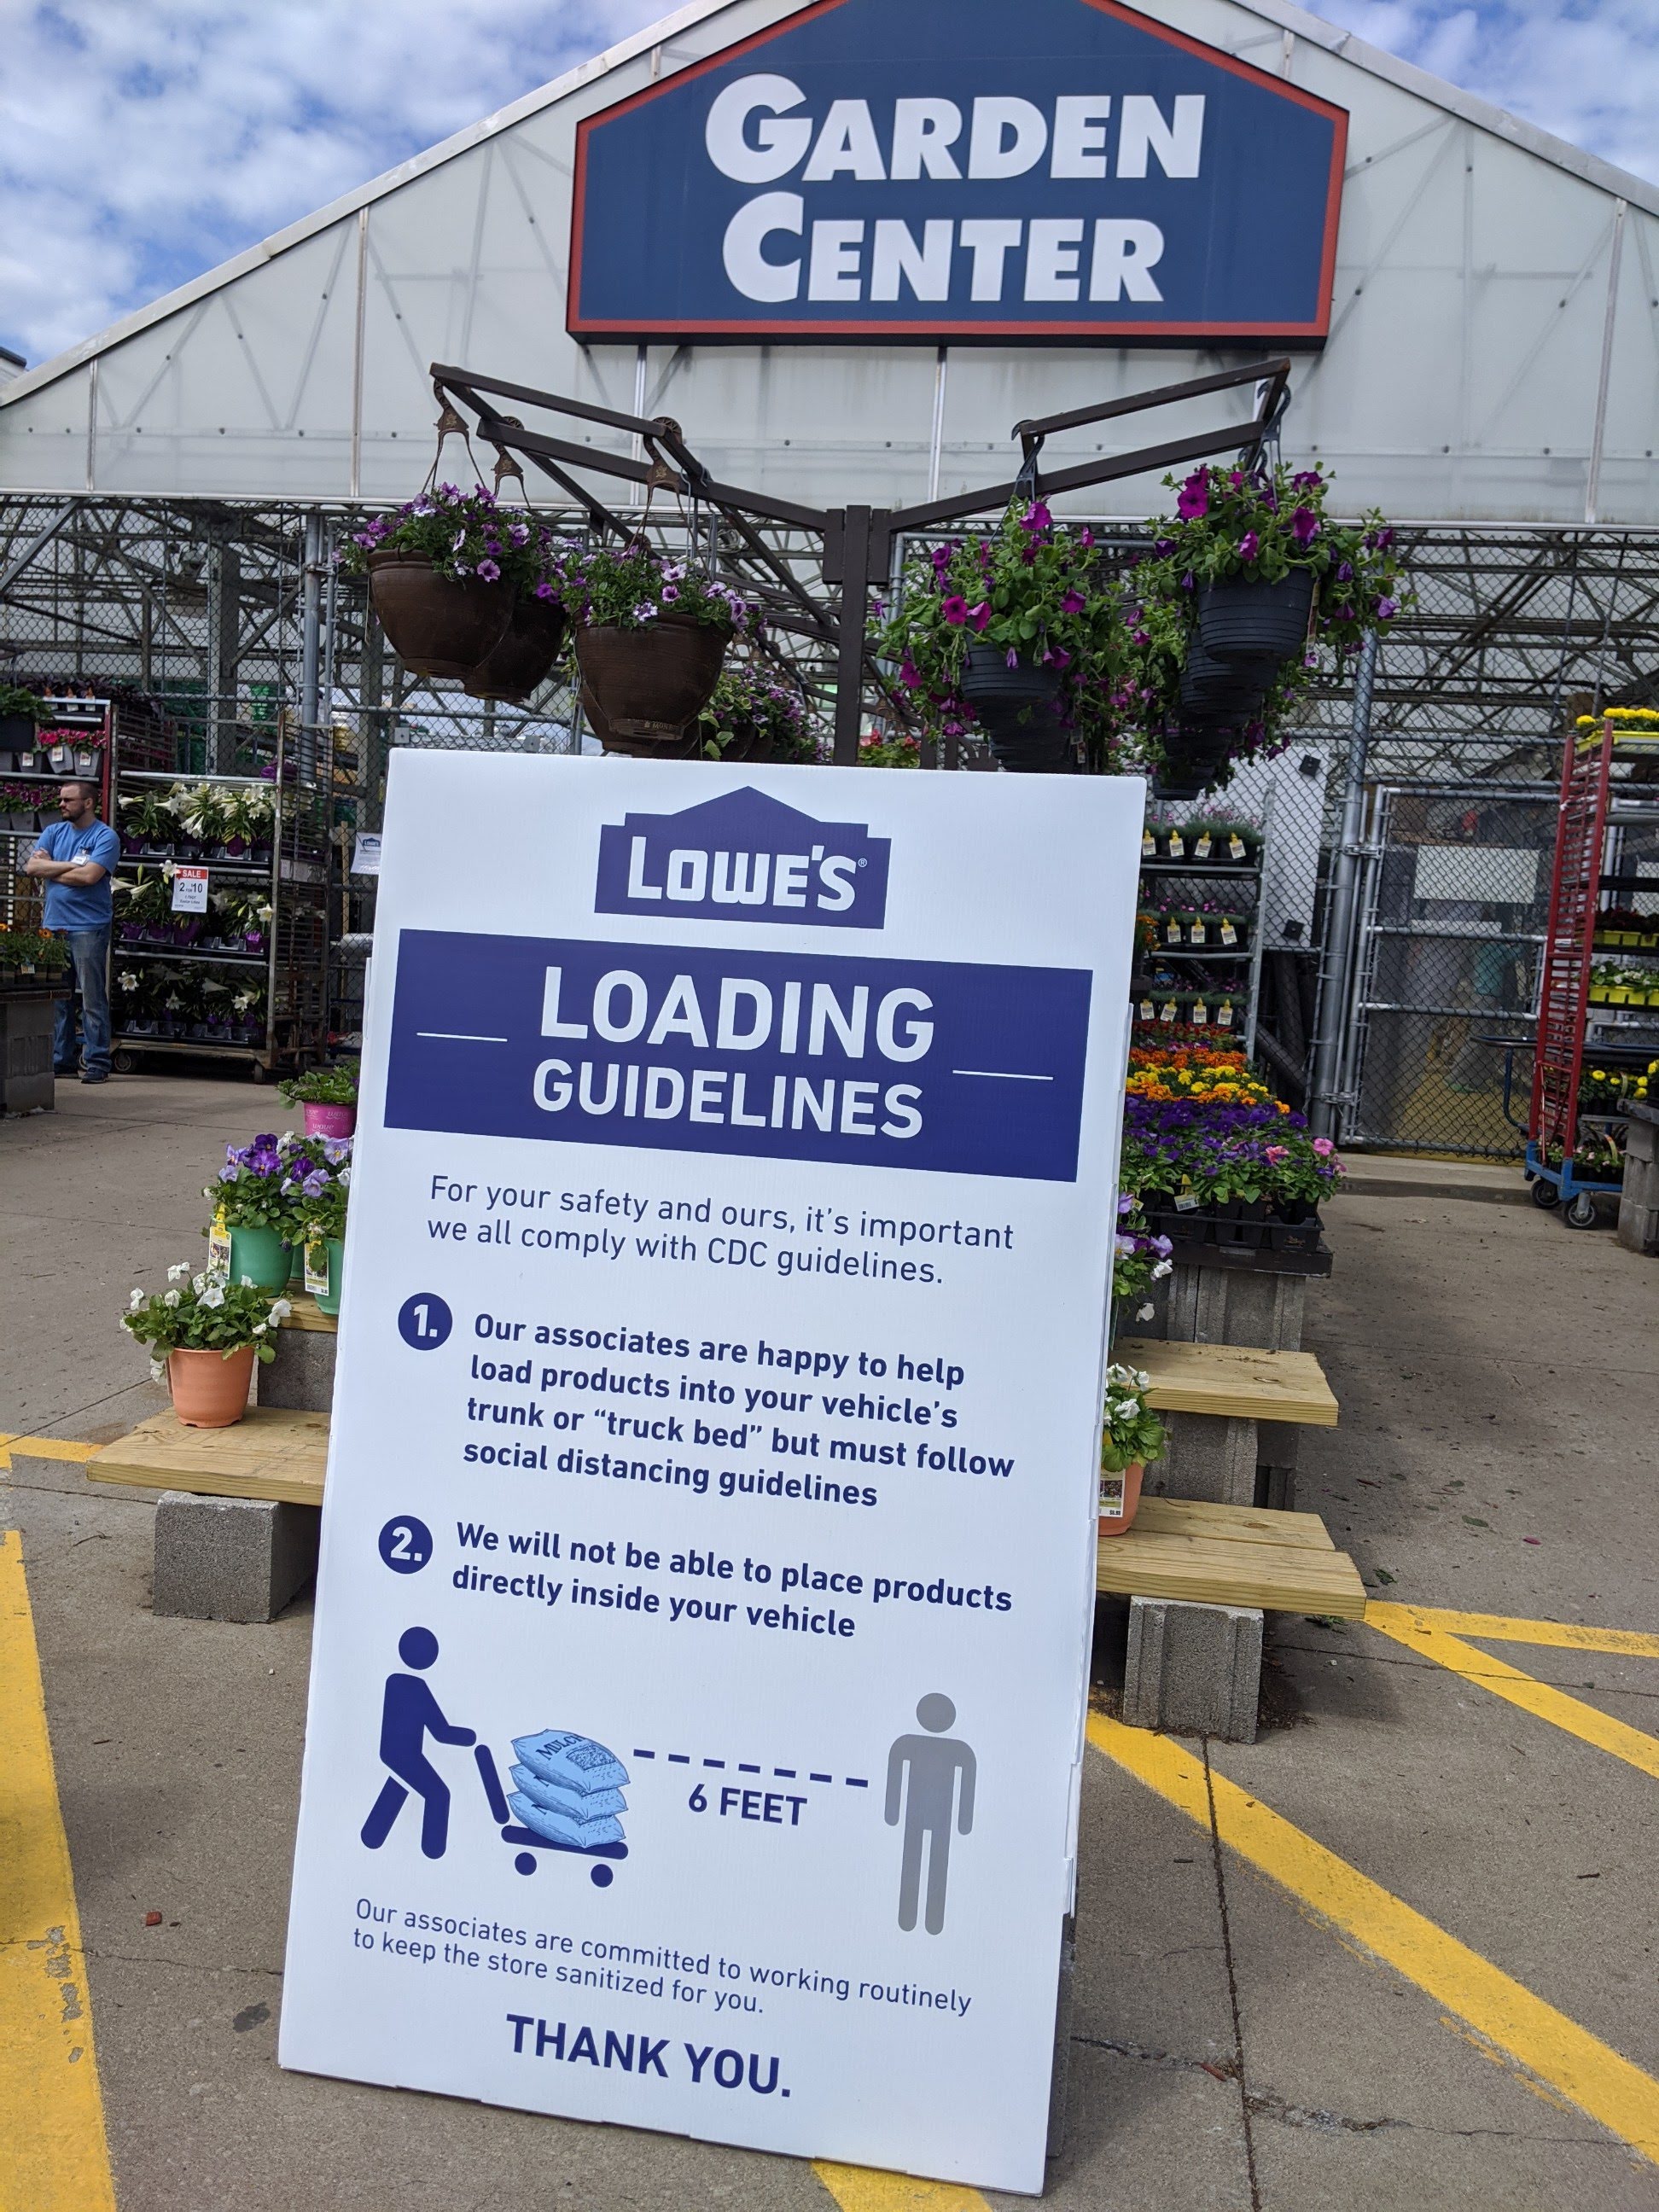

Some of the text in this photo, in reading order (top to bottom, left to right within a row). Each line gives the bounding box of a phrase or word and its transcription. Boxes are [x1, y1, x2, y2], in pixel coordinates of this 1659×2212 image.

[704, 72, 1206, 184] GARDEN
[722, 190, 1165, 303] CENTER
[179, 882, 185, 892] 2
[182, 869, 201, 878] SALE
[627, 835, 857, 911] LOWE'S
[539, 965, 935, 1064] LOADING
[533, 1058, 924, 1140] GUIDELINES
[431, 1174, 478, 1203] For
[486, 1186, 551, 1211] your
[559, 1188, 649, 1223] safety
[658, 1197, 712, 1223] and
[721, 1206, 795, 1234] ours,
[860, 1210, 1014, 1250] important
[428, 1219, 942, 1284] we all comply with CDC guidelines.
[413, 1304, 964, 1391] 1. Our associates are happy to help
[471, 1353, 533, 1384] load
[540, 1366, 670, 1399] products
[679, 1374, 736, 1405] into
[744, 1388, 814, 1413] your
[463, 1441, 877, 1507] social distancing guidelines
[467, 1397, 544, 1428] trunk
[553, 1411, 585, 1431] or
[771, 1427, 820, 1458] but
[830, 1440, 907, 1467] must
[917, 1442, 1016, 1478] follow
[390, 1521, 1012, 1612] 2. We will not be able to place products
[452, 1564, 856, 1638] directly inside your vehicle
[535, 1733, 587, 1761] MULCH
[688, 1783, 808, 1826] 6 FEET
[353, 1928, 763, 2014] to keep the store sanitized for you.
[356, 1898, 972, 2017] Our associates are committed to working routinely
[505, 2013, 791, 2098] THANK YOU.
